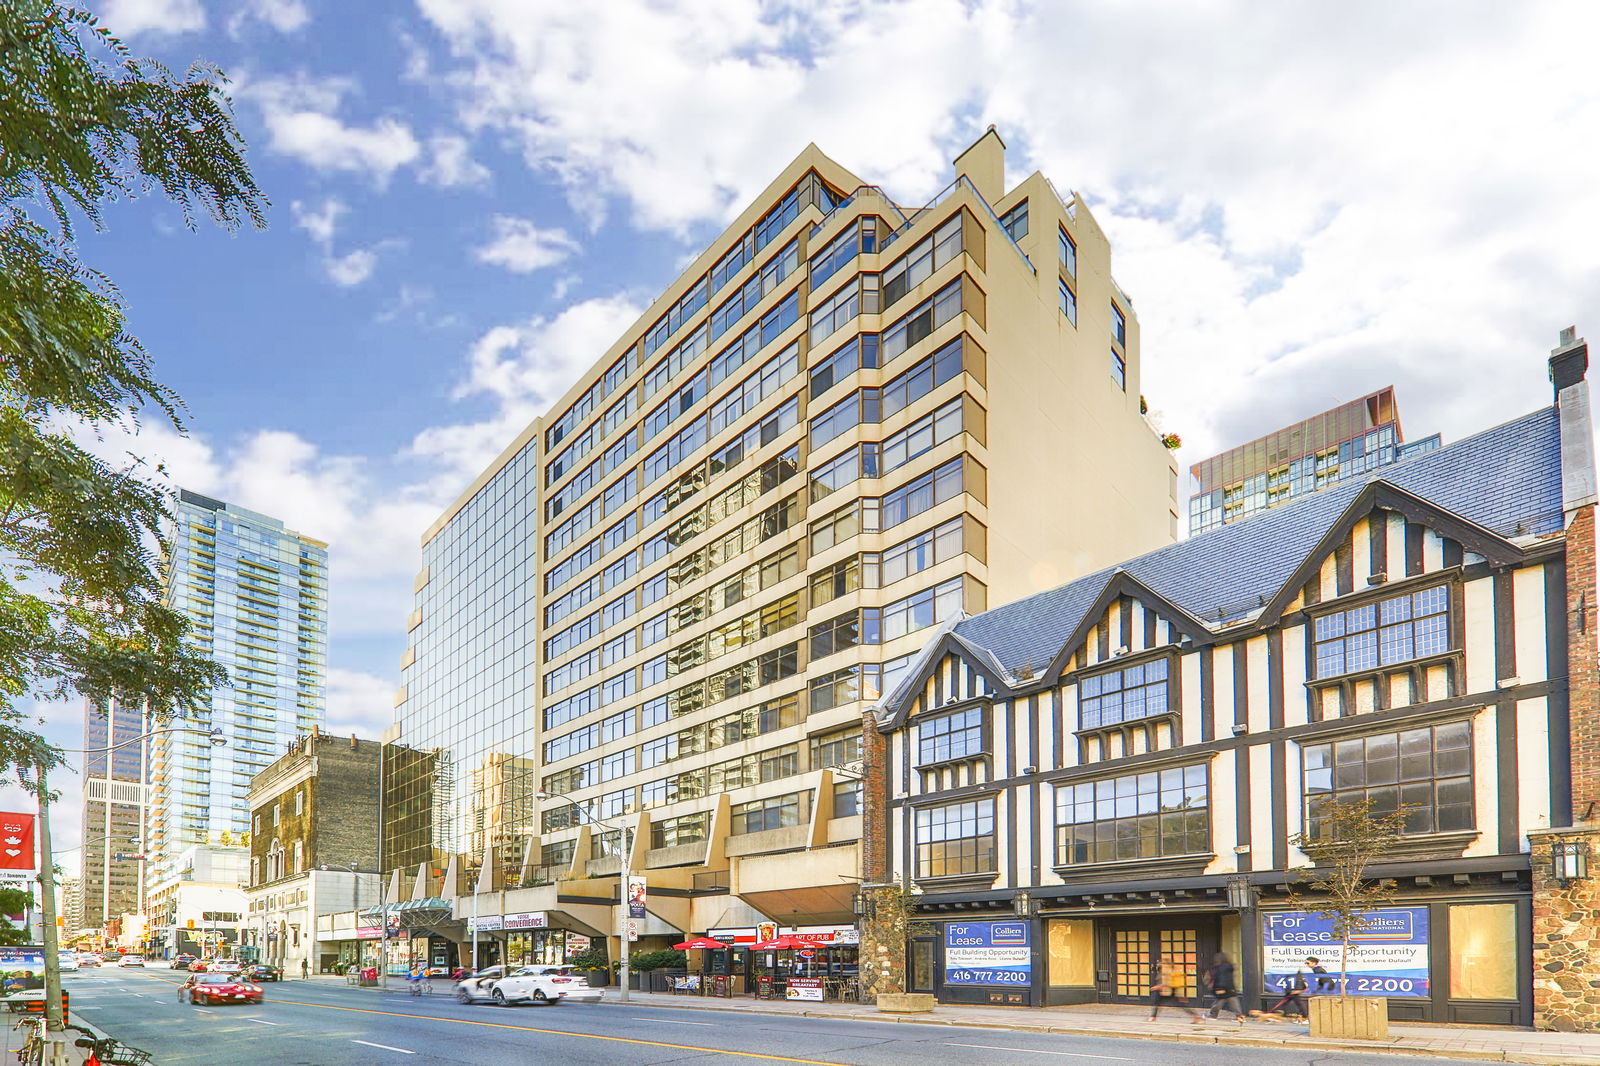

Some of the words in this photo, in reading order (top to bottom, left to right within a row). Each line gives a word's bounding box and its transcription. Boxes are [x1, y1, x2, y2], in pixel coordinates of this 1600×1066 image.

[504, 918, 543, 928] CONVENIENCE
[1269, 915, 1305, 928] For
[949, 925, 969, 935] For
[949, 936, 983, 945] Lease
[1269, 929, 1332, 942] Lease
[1271, 948, 1291, 956] Full
[1294, 948, 1340, 957] Building
[1346, 947, 1417, 957] Opportunity
[953, 971, 971, 980] 416
[973, 971, 993, 980] 777
[996, 972, 1026, 981] 2200
[1357, 978, 1413, 992] 2200
